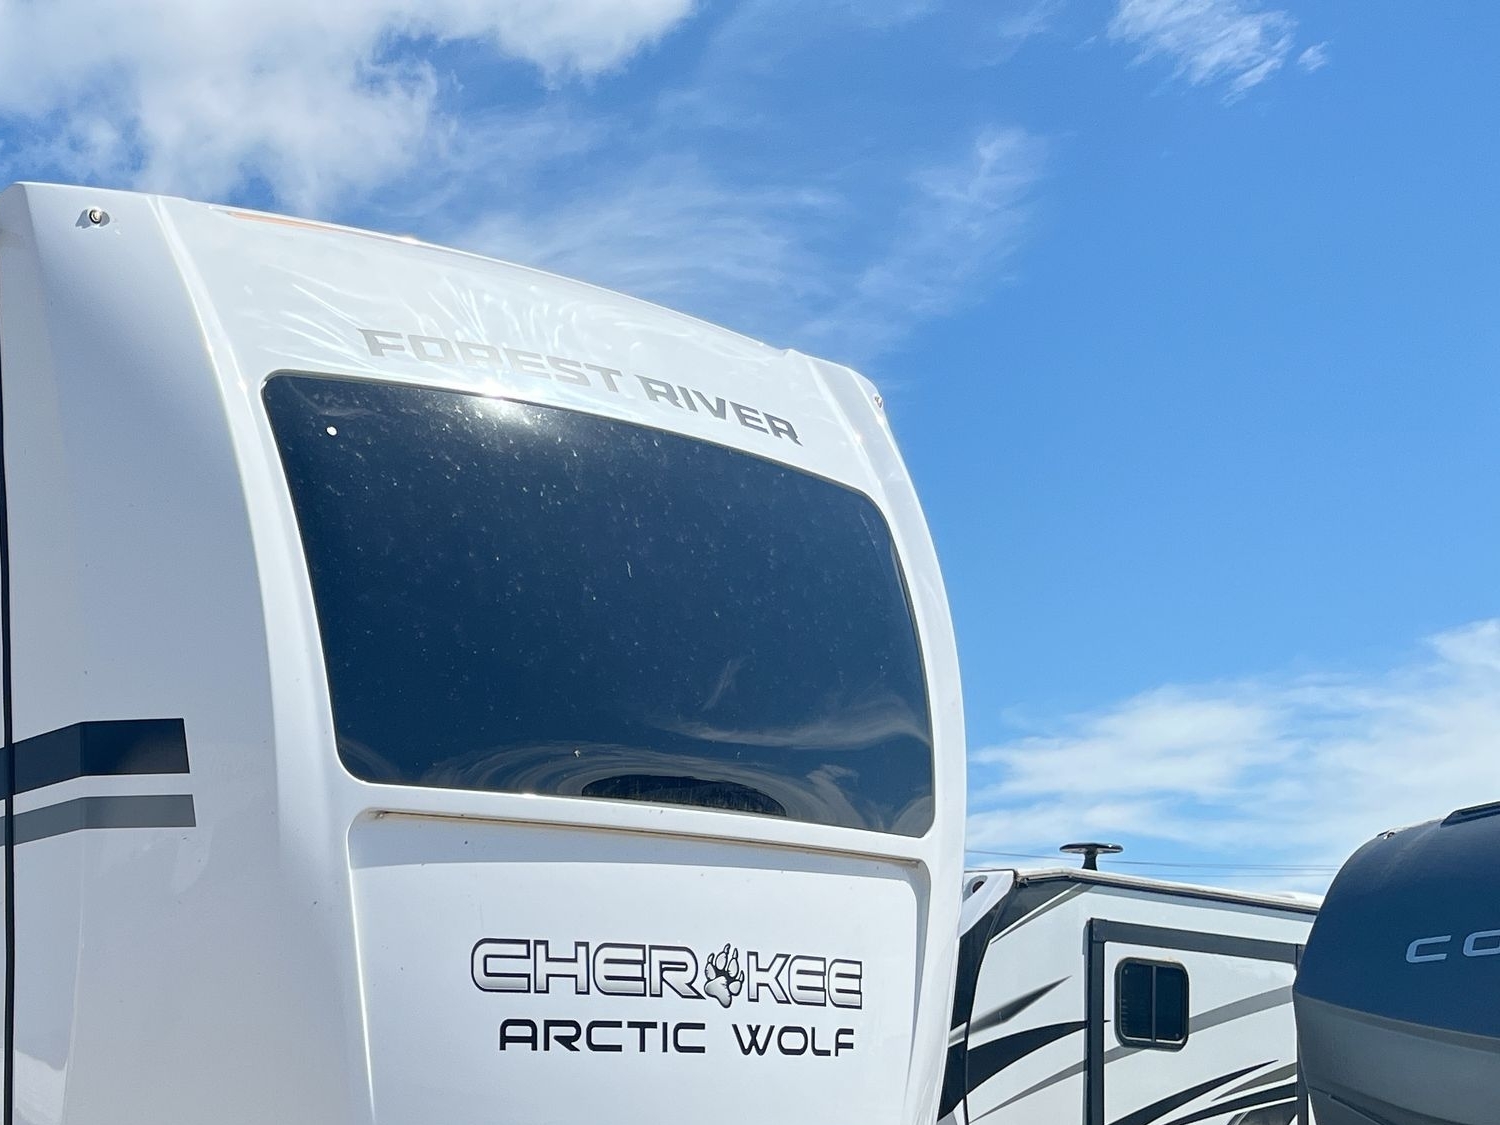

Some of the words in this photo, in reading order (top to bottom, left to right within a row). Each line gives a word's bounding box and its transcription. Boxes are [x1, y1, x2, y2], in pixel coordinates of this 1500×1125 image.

[358, 328, 621, 393] FOREST
[634, 374, 802, 446] RIVER
[1406, 929, 1500, 963] CO
[500, 1019, 705, 1053] ARCTIC
[732, 1023, 854, 1057] WOLF
